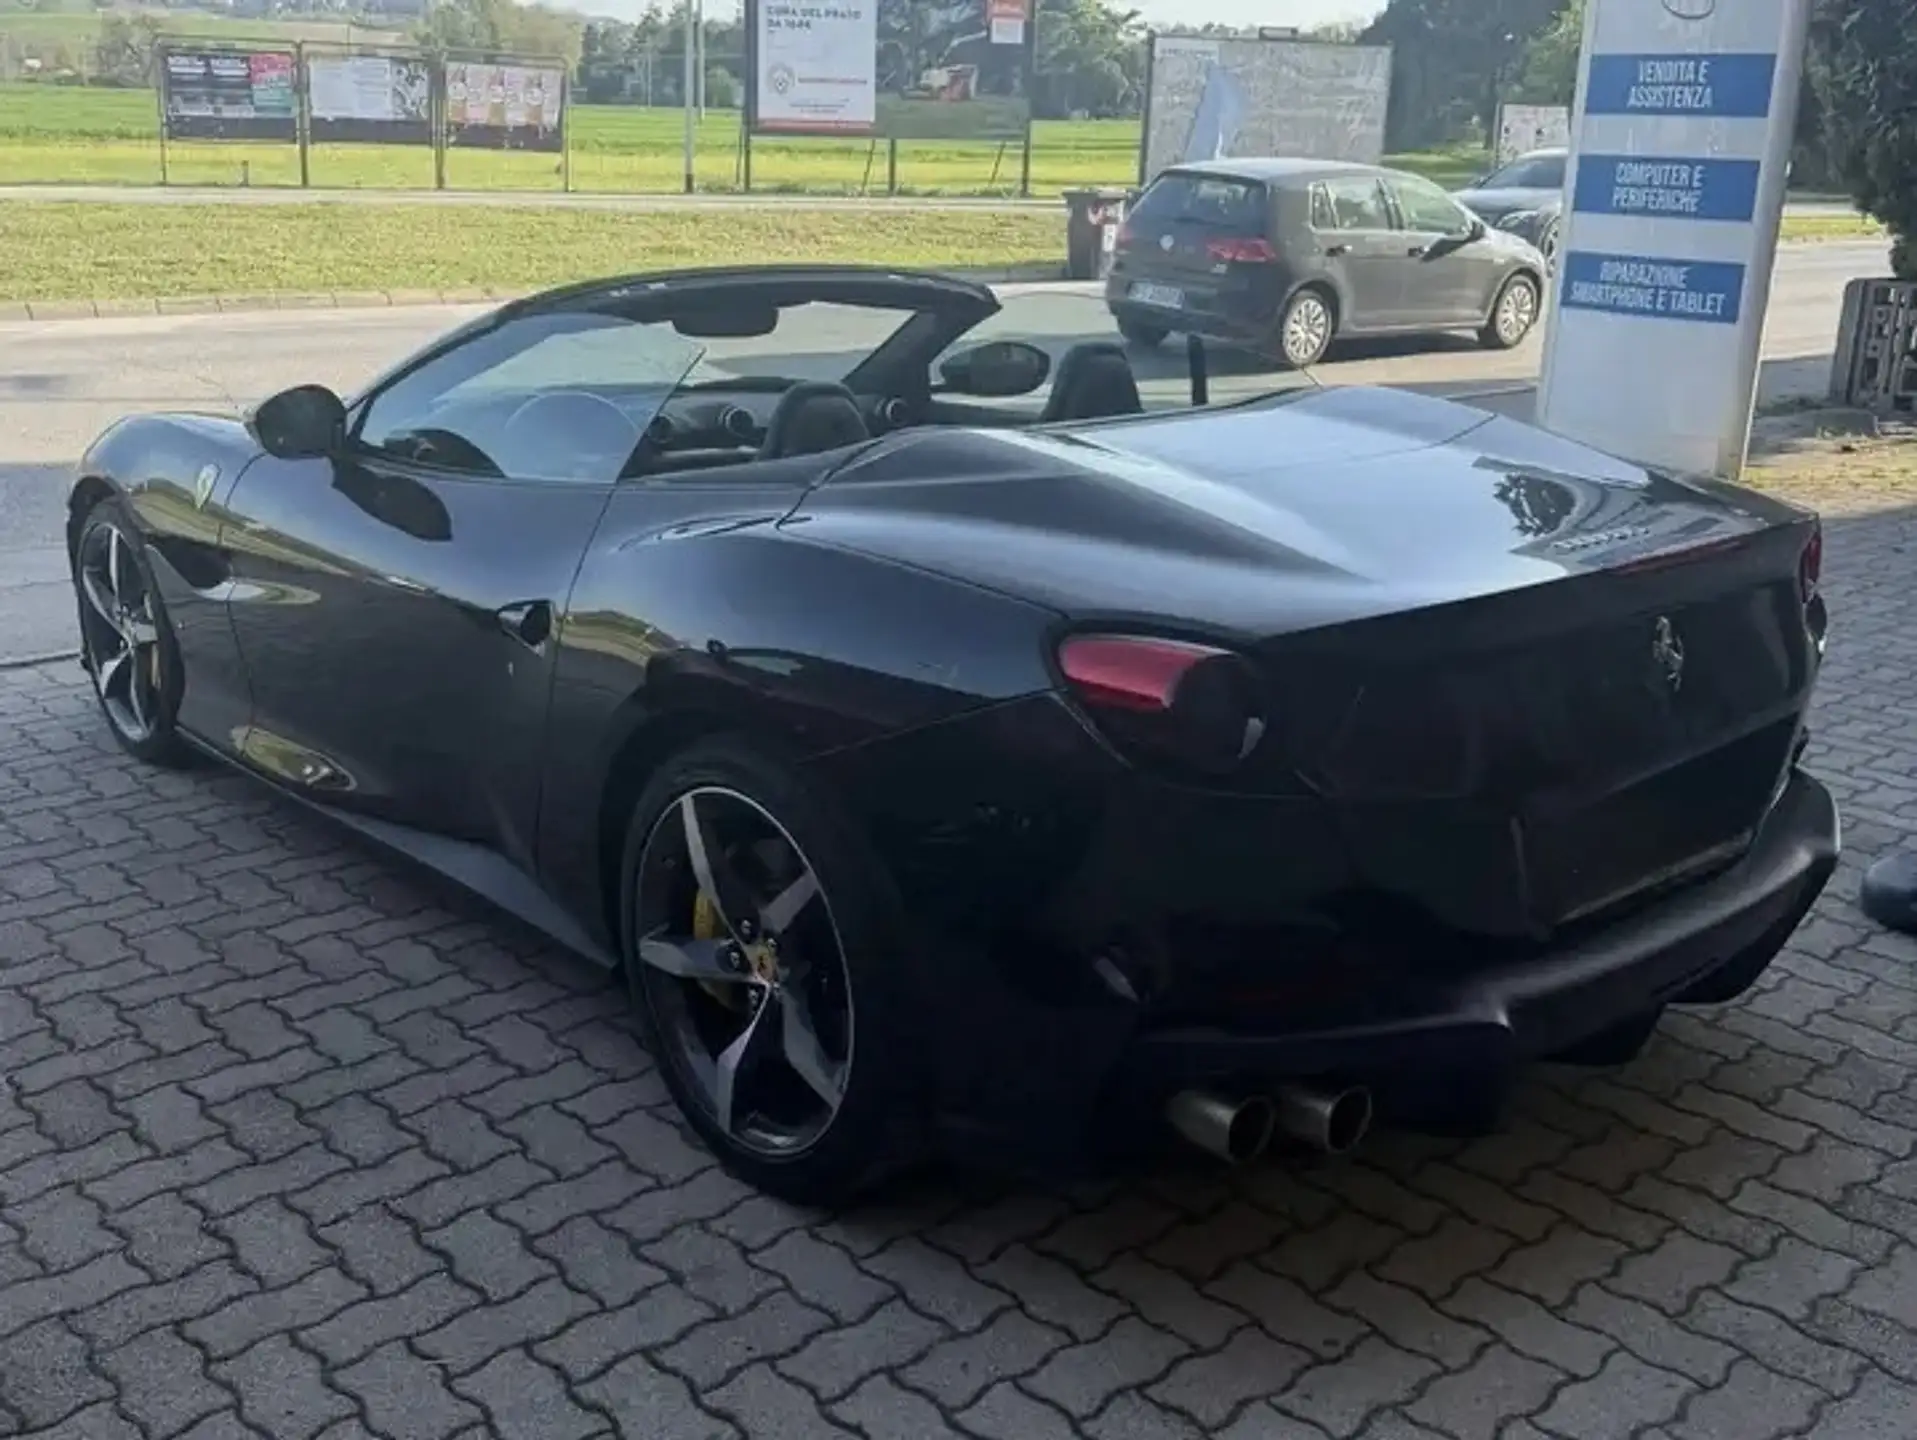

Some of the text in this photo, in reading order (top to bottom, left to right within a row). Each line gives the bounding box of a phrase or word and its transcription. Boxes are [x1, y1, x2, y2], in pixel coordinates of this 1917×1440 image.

[1639, 60, 1711, 83] VENDITA E
[1627, 85, 1713, 109] ASSISTENZA
[1615, 162, 1706, 188] COMPUTER E
[1612, 186, 1702, 213] PERIFERICHE
[1656, 286, 1668, 311] E
[1670, 290, 1726, 316] TABLET
